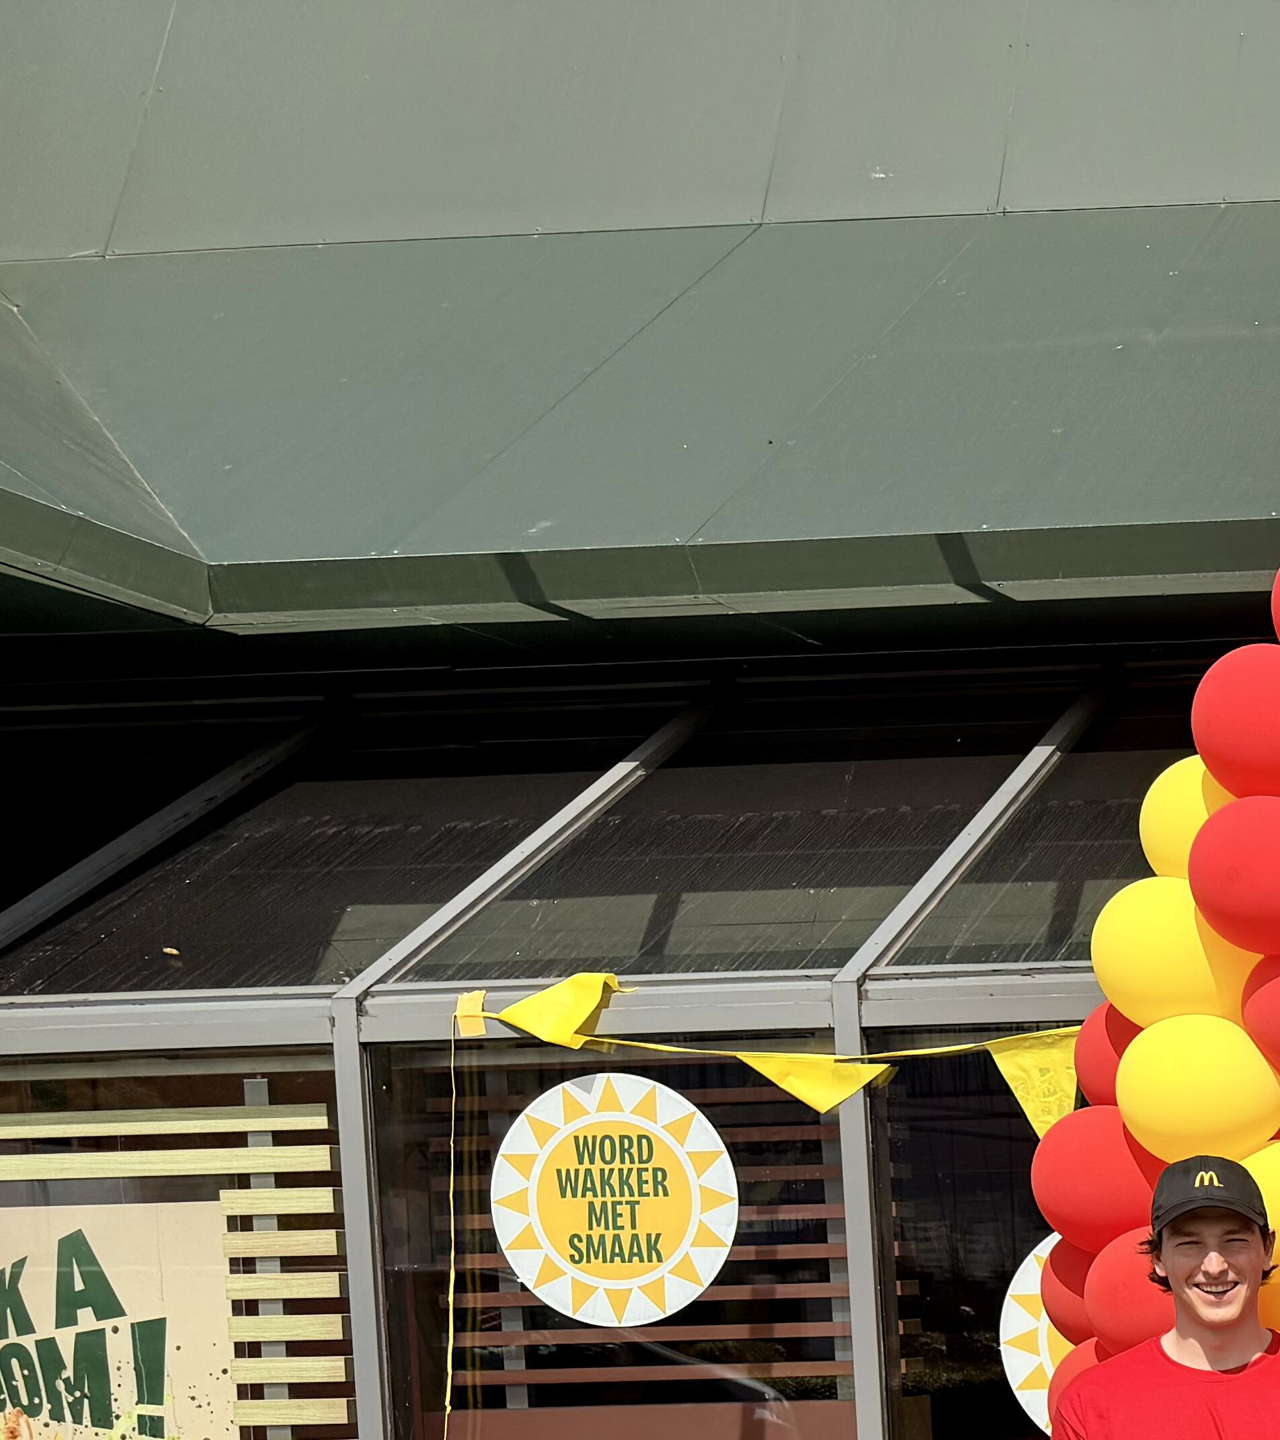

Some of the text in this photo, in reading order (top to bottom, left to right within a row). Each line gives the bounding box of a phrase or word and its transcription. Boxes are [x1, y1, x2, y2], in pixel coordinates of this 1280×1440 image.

[573, 1134, 654, 1166] WORD
[556, 1167, 669, 1199] WAKKER
[587, 1200, 640, 1231] MET
[568, 1233, 664, 1265] SMAAK
[55, 1228, 128, 1330] A
[0, 1317, 167, 1439] OM!
